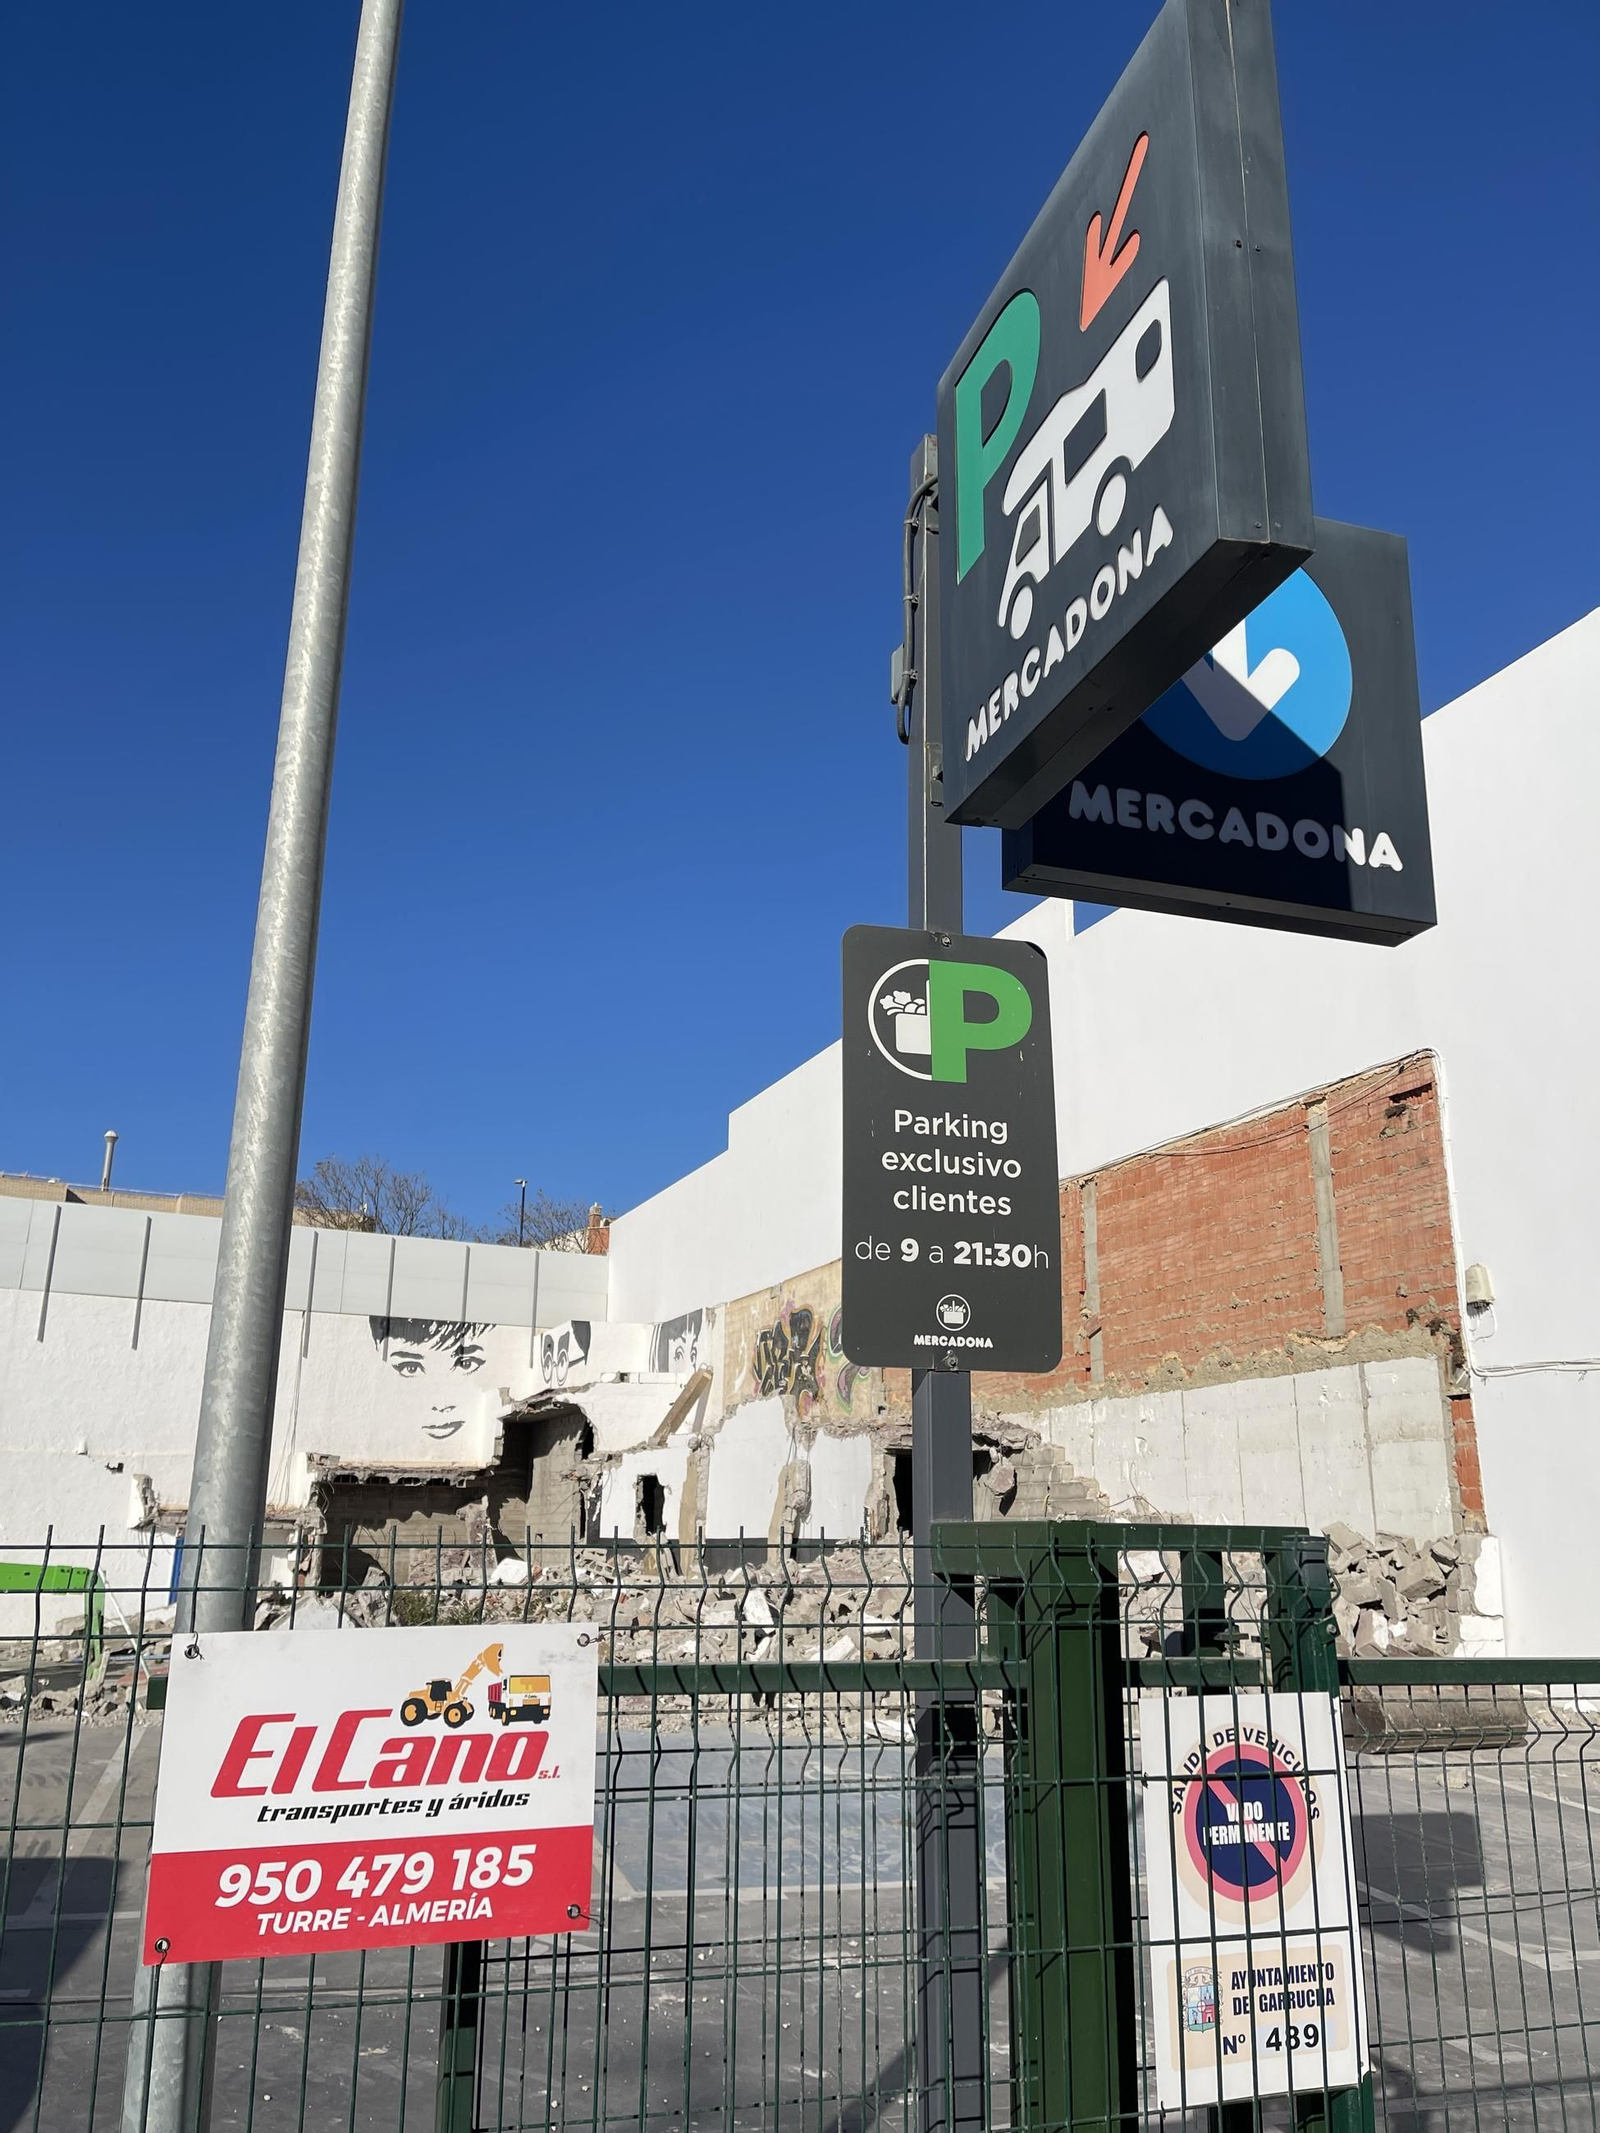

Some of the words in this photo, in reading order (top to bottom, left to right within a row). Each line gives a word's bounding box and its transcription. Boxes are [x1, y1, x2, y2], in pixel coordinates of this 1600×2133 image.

[954, 288, 1042, 586] P
[962, 504, 1175, 763] MERCADONA
[1068, 780, 1404, 872] MERCADONA
[929, 959, 1033, 1084] P
[894, 1109, 1009, 1145] Parking
[881, 1149, 1022, 1180] exclusivo
[893, 1187, 1012, 1216] clientes
[855, 1235, 891, 1261] de
[900, 1237, 920, 1262] 9
[928, 1245, 944, 1264] a
[953, 1240, 1049, 1269] 21:30h
[913, 1334, 994, 1349] MERCADONA
[311, 1708, 550, 1793] Cano
[537, 1764, 561, 1780] s.l.
[1213, 1727, 1238, 1748] DE
[256, 1797, 424, 1825] transportes
[425, 1796, 445, 1818] y
[448, 1788, 531, 1812] áridos
[213, 1858, 323, 1908] 950
[335, 1850, 435, 1899] 479
[450, 1844, 537, 1890] 185
[256, 1907, 352, 1936] TURRE
[368, 1892, 493, 1928] ALMERÍA
[1231, 1962, 1335, 1991] AYNTAMIENO
[1233, 1996, 1250, 2016] DE
[1265, 2023, 1319, 2052] 489
